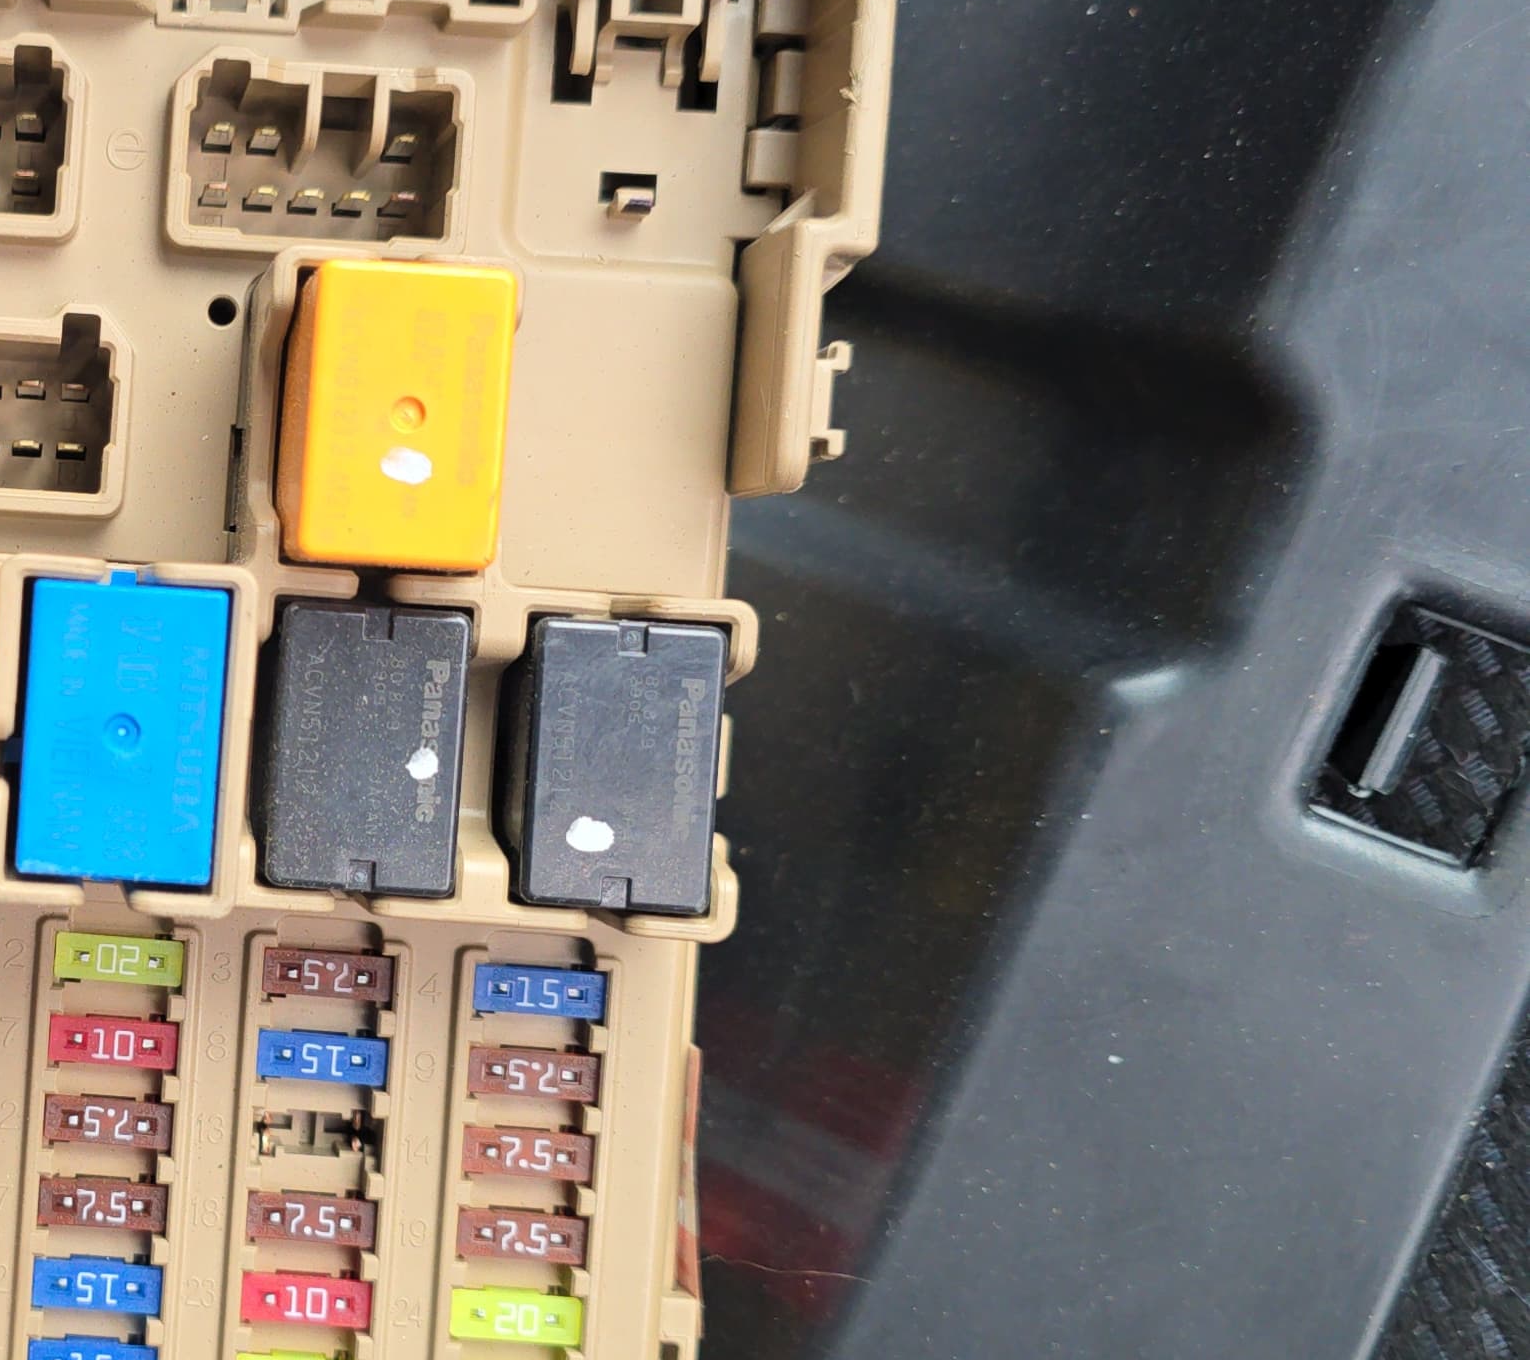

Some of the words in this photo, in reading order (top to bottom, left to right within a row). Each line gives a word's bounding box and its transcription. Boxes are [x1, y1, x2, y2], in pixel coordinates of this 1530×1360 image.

[106, 127, 148, 171] e
[294, 654, 326, 797] ACVN51212
[414, 659, 451, 824] Panasnic
[671, 677, 707, 841] Panasonic
[4, 939, 24, 968] 2
[96, 944, 140, 974] 20
[211, 953, 231, 982] 3
[302, 959, 349, 991] 7.5
[420, 972, 440, 1004] 4
[515, 977, 559, 1008] 15
[0, 1017, 19, 1048] 7
[91, 1028, 134, 1061] 10
[207, 1032, 226, 1060] 8
[301, 1044, 344, 1076] 15
[415, 1051, 435, 1081] 9
[508, 1059, 557, 1092] 7.5
[83, 1106, 133, 1138] 7.5
[197, 1114, 223, 1143] 13
[407, 1136, 431, 1163] 14
[501, 1138, 552, 1170] 7.5
[76, 1190, 127, 1224] 7.5
[192, 1198, 218, 1226] 18
[286, 1204, 336, 1238] 7.5
[400, 1219, 426, 1246] 19
[496, 1221, 547, 1253] 7.5
[76, 1271, 119, 1303] 15
[183, 1278, 214, 1306] 23
[285, 1287, 327, 1320] 10
[393, 1298, 424, 1327] 24
[494, 1302, 538, 1336] 20
